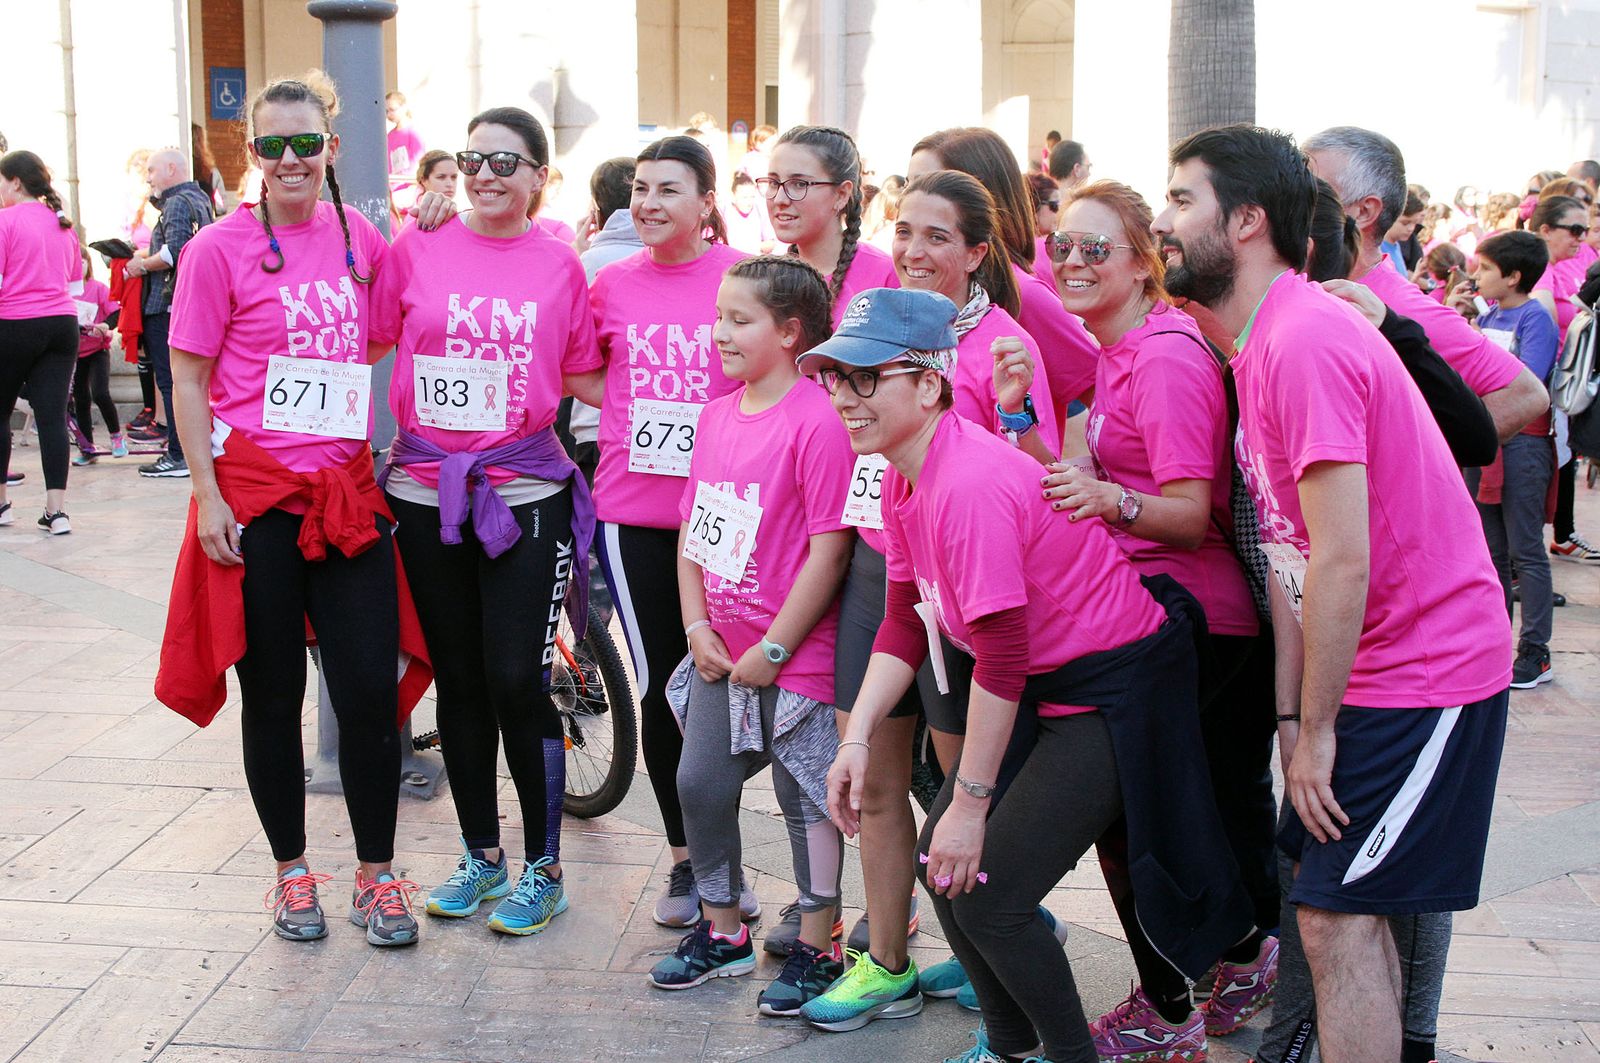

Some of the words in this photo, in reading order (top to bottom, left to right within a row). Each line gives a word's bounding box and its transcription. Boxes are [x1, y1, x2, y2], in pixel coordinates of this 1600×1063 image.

[279, 276, 358, 329] KM
[446, 294, 537, 343] KM
[627, 324, 712, 368] KM
[285, 363, 318, 375] Carrera
[320, 367, 330, 376] de
[332, 368, 340, 377] la
[341, 371, 366, 380] Mujer
[426, 362, 454, 373] Carrera
[456, 365, 467, 373] de
[469, 365, 477, 373] la
[629, 367, 710, 401] POR
[269, 377, 327, 410] 671
[419, 376, 469, 408] 183
[650, 407, 681, 418] Carrera
[683, 410, 694, 419] de
[635, 420, 695, 453] 673
[692, 504, 726, 546] 765
